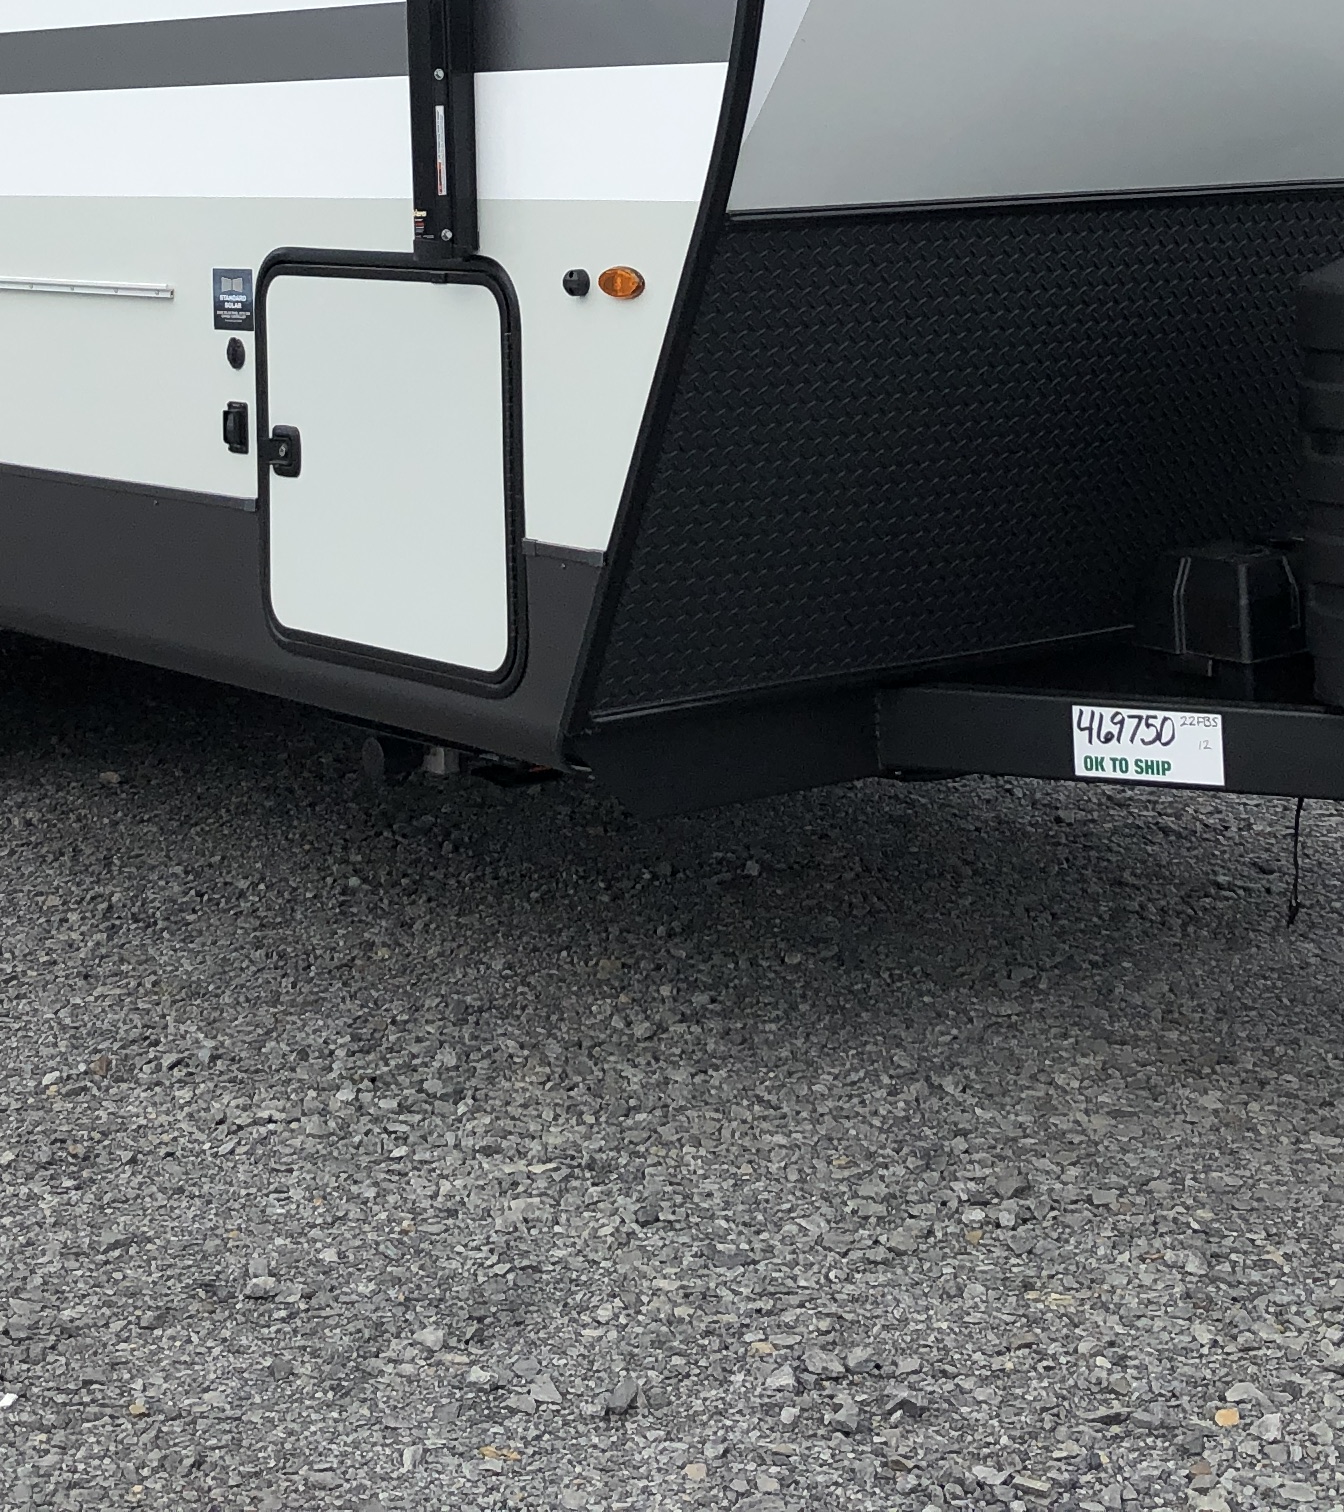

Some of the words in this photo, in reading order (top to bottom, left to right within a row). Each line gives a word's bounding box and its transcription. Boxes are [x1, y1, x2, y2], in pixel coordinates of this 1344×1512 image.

[1076, 707, 1177, 748] 469750
[1083, 754, 1106, 773] OK
[1109, 756, 1129, 775] TO
[1133, 758, 1173, 777] SHIP
